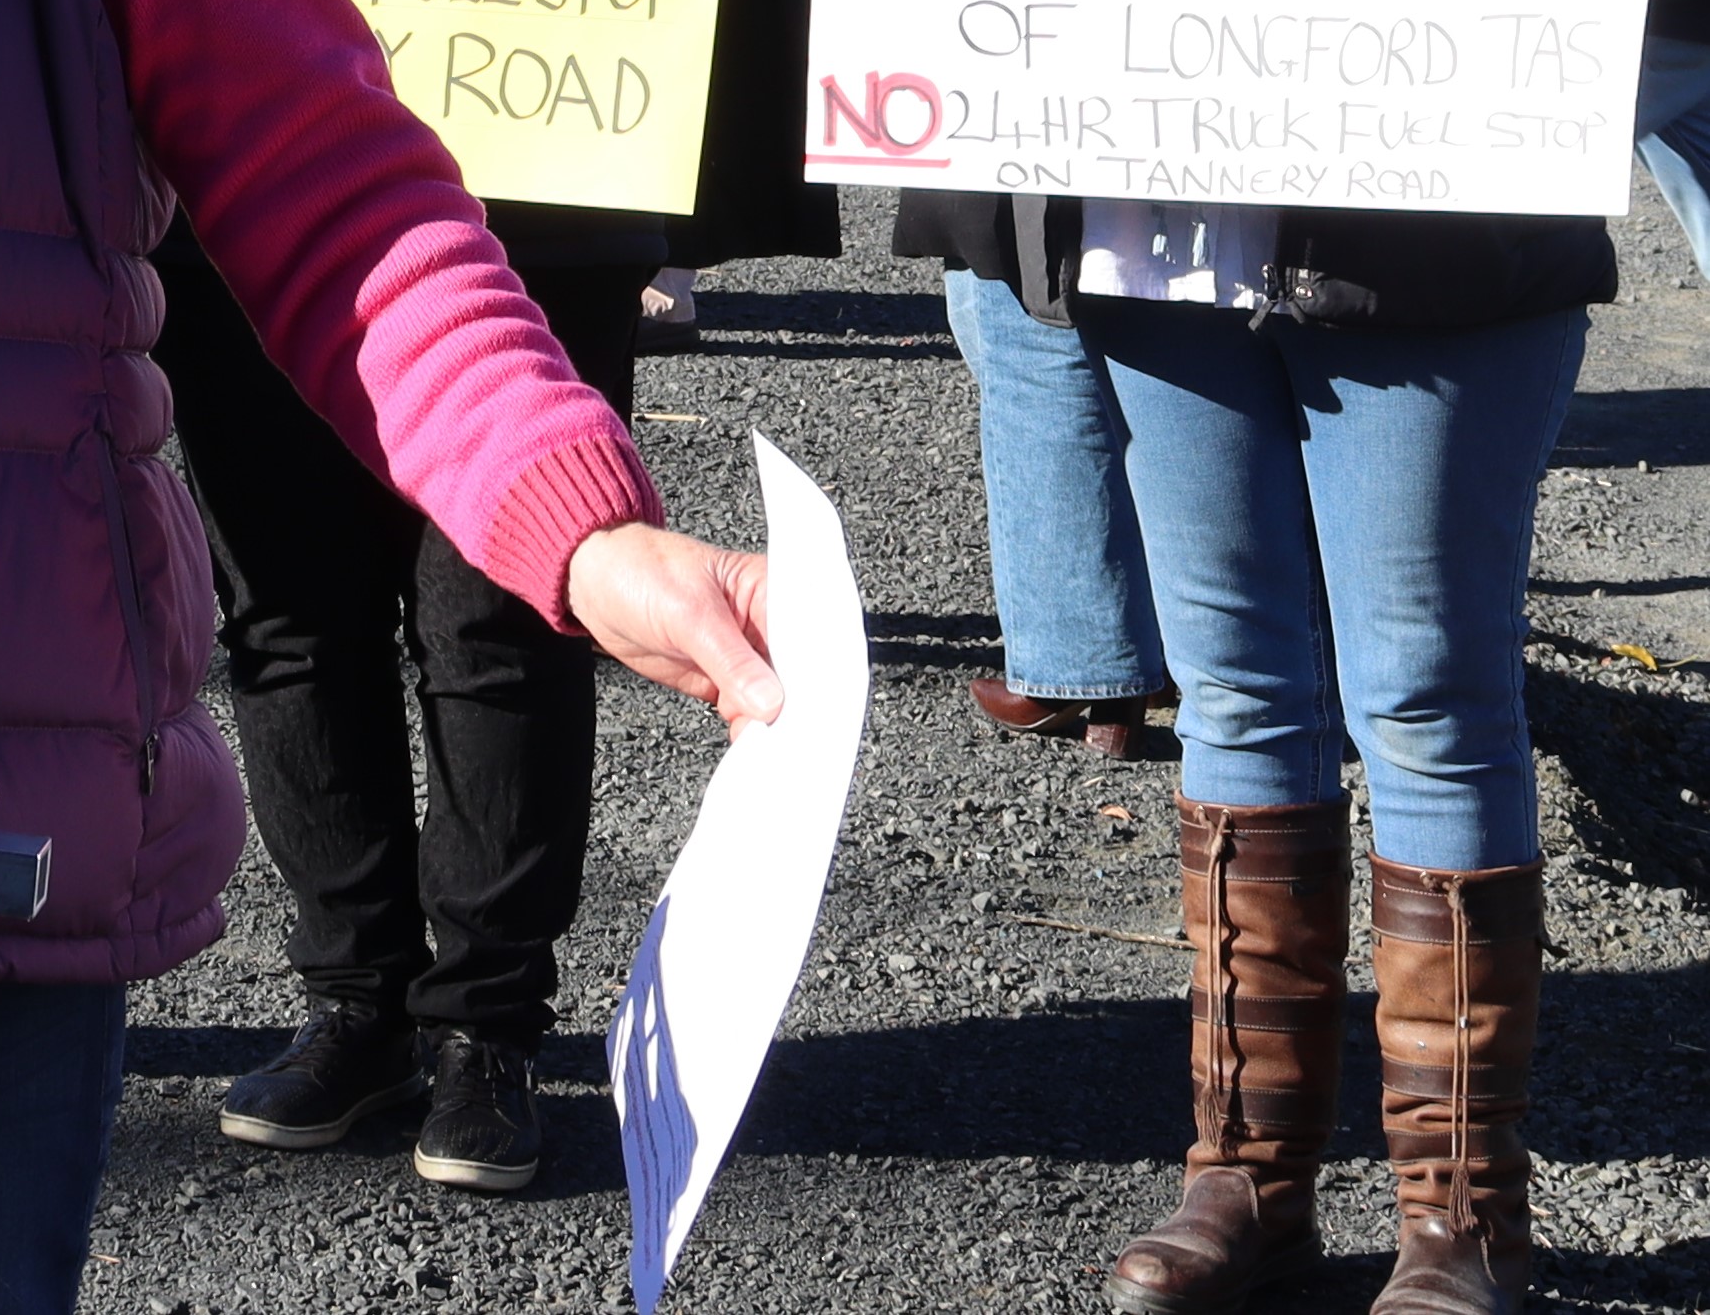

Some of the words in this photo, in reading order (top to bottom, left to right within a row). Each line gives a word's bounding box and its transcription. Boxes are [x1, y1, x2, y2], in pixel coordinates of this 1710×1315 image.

[443, 32, 650, 134] ROAD
[958, 0, 1078, 70] OF
[1124, 3, 1458, 87] LONGFORD
[1480, 13, 1603, 94] TAS
[819, 70, 943, 155] NO
[1131, 96, 1319, 155] TRUCK
[1338, 100, 1470, 154] FUEL
[1486, 111, 1608, 155] STOP
[996, 158, 1071, 188] ON
[1097, 156, 1329, 199] TANNERY
